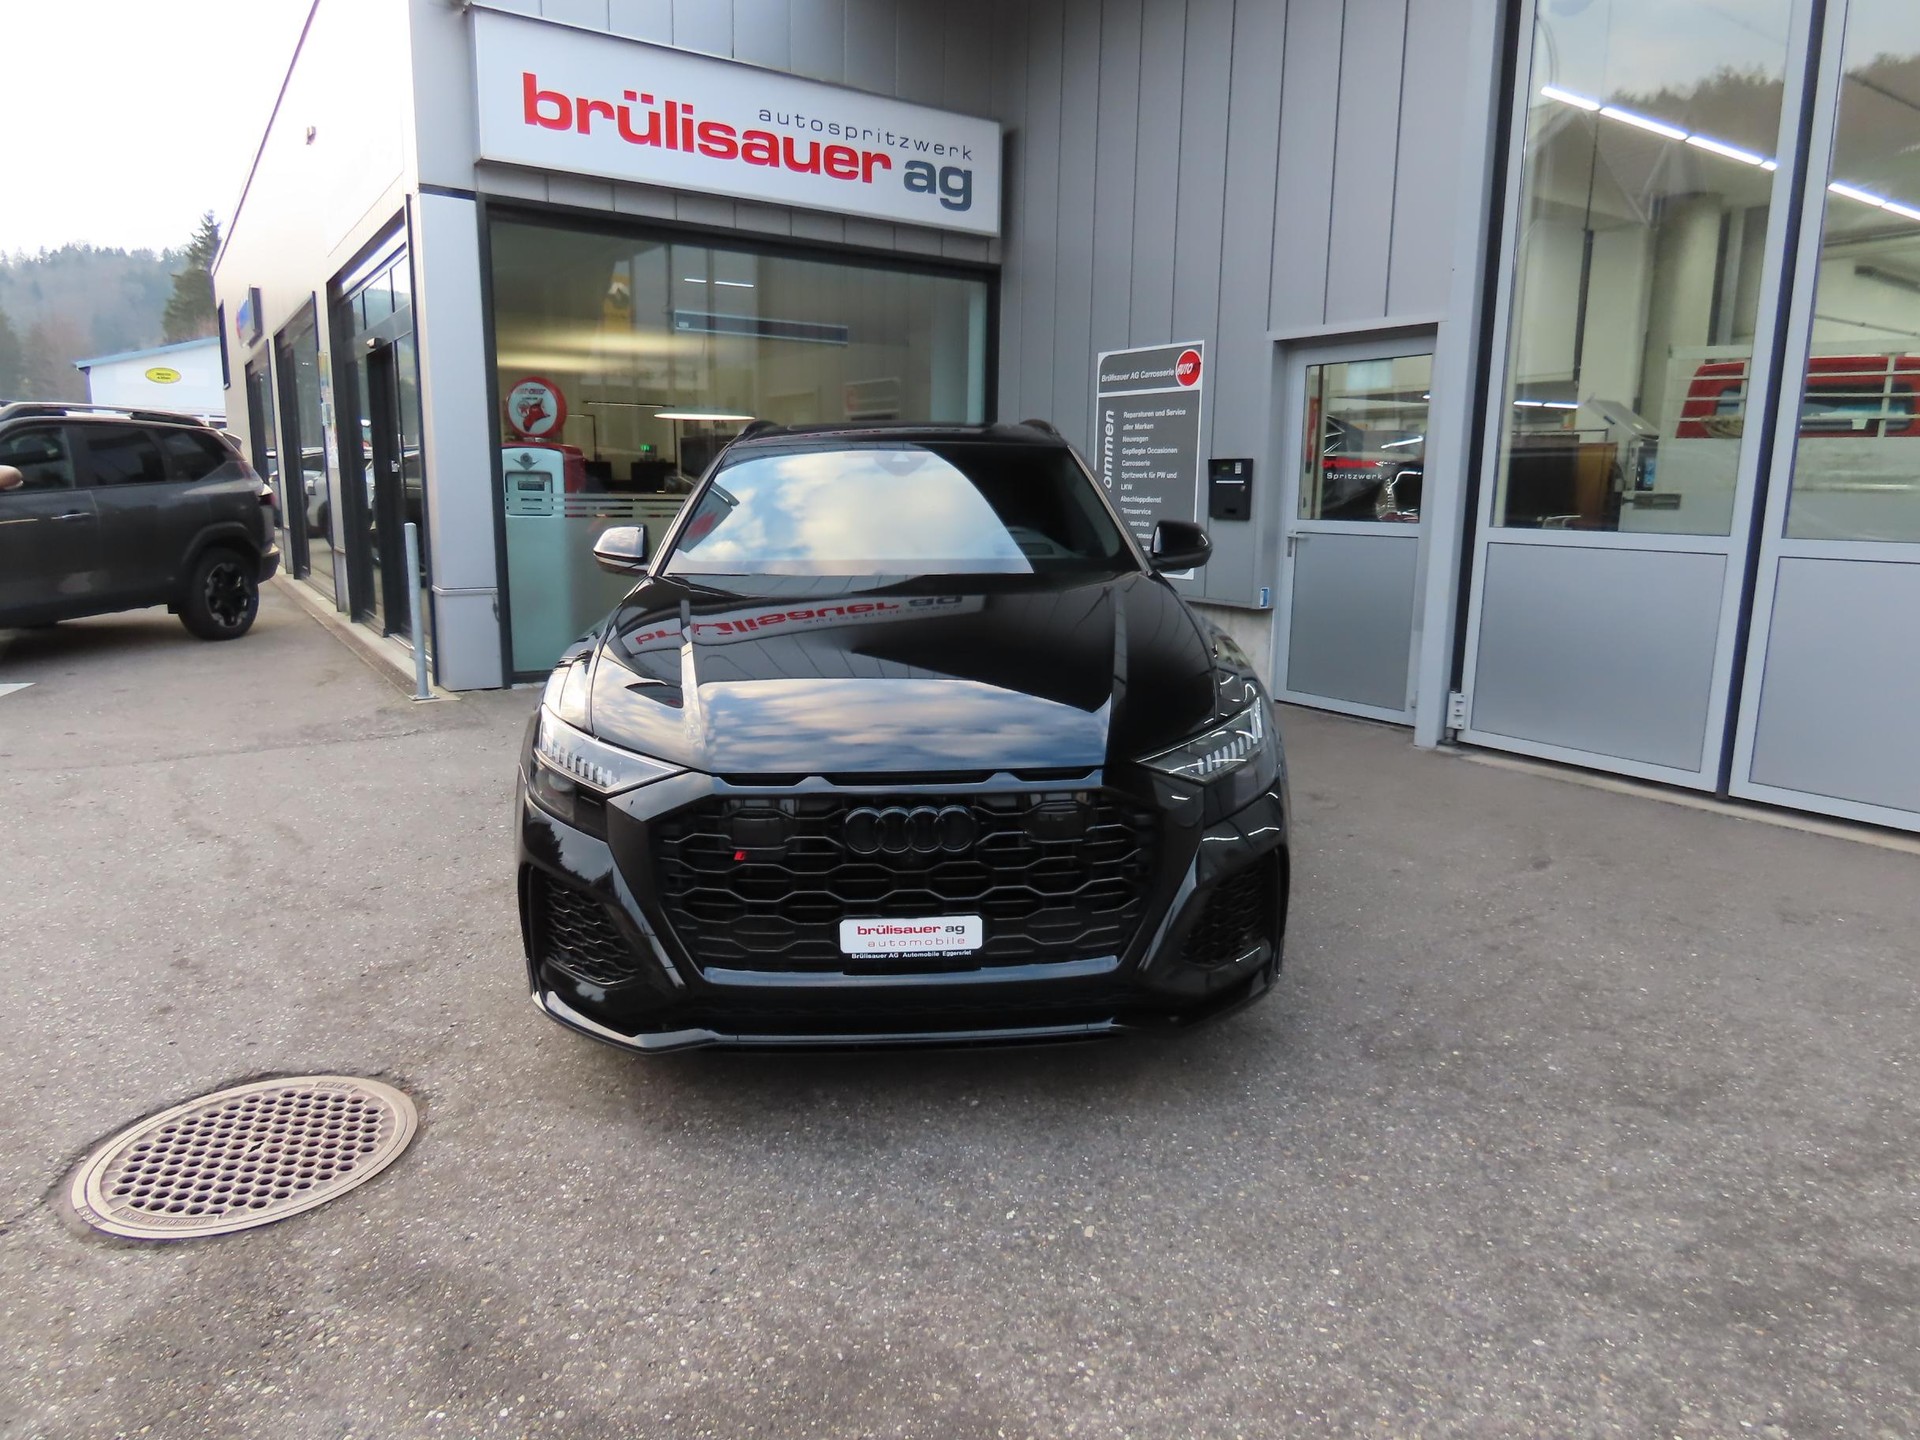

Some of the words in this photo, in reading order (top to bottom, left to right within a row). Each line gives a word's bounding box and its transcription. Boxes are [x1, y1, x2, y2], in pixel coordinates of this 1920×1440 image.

[758, 106, 973, 161] autospritzwerk
[522, 72, 892, 184] brülisauer
[903, 160, 973, 213] ag
[1130, 371, 1140, 380] AG
[1140, 367, 1175, 379] Carrosserie
[1123, 411, 1154, 419] Reparaturen
[1154, 409, 1165, 417] und
[1166, 408, 1186, 416] Service
[1103, 409, 1115, 490] ommen
[1121, 447, 1146, 456] Gepflegte
[1146, 447, 1178, 455] Occasionen
[1121, 459, 1151, 467] Carrosserie
[1121, 471, 1148, 480] Spritzwerk
[1148, 471, 1156, 479] für
[1156, 471, 1166, 479] PW
[1166, 471, 1177, 479] und
[1326, 472, 1383, 480] Spritzwerk
[1120, 483, 1133, 491] LKW
[1120, 495, 1162, 504] Abschleppdienst
[857, 925, 942, 935] brülisauer
[944, 925, 965, 935] ag
[867, 937, 966, 948] automobile
